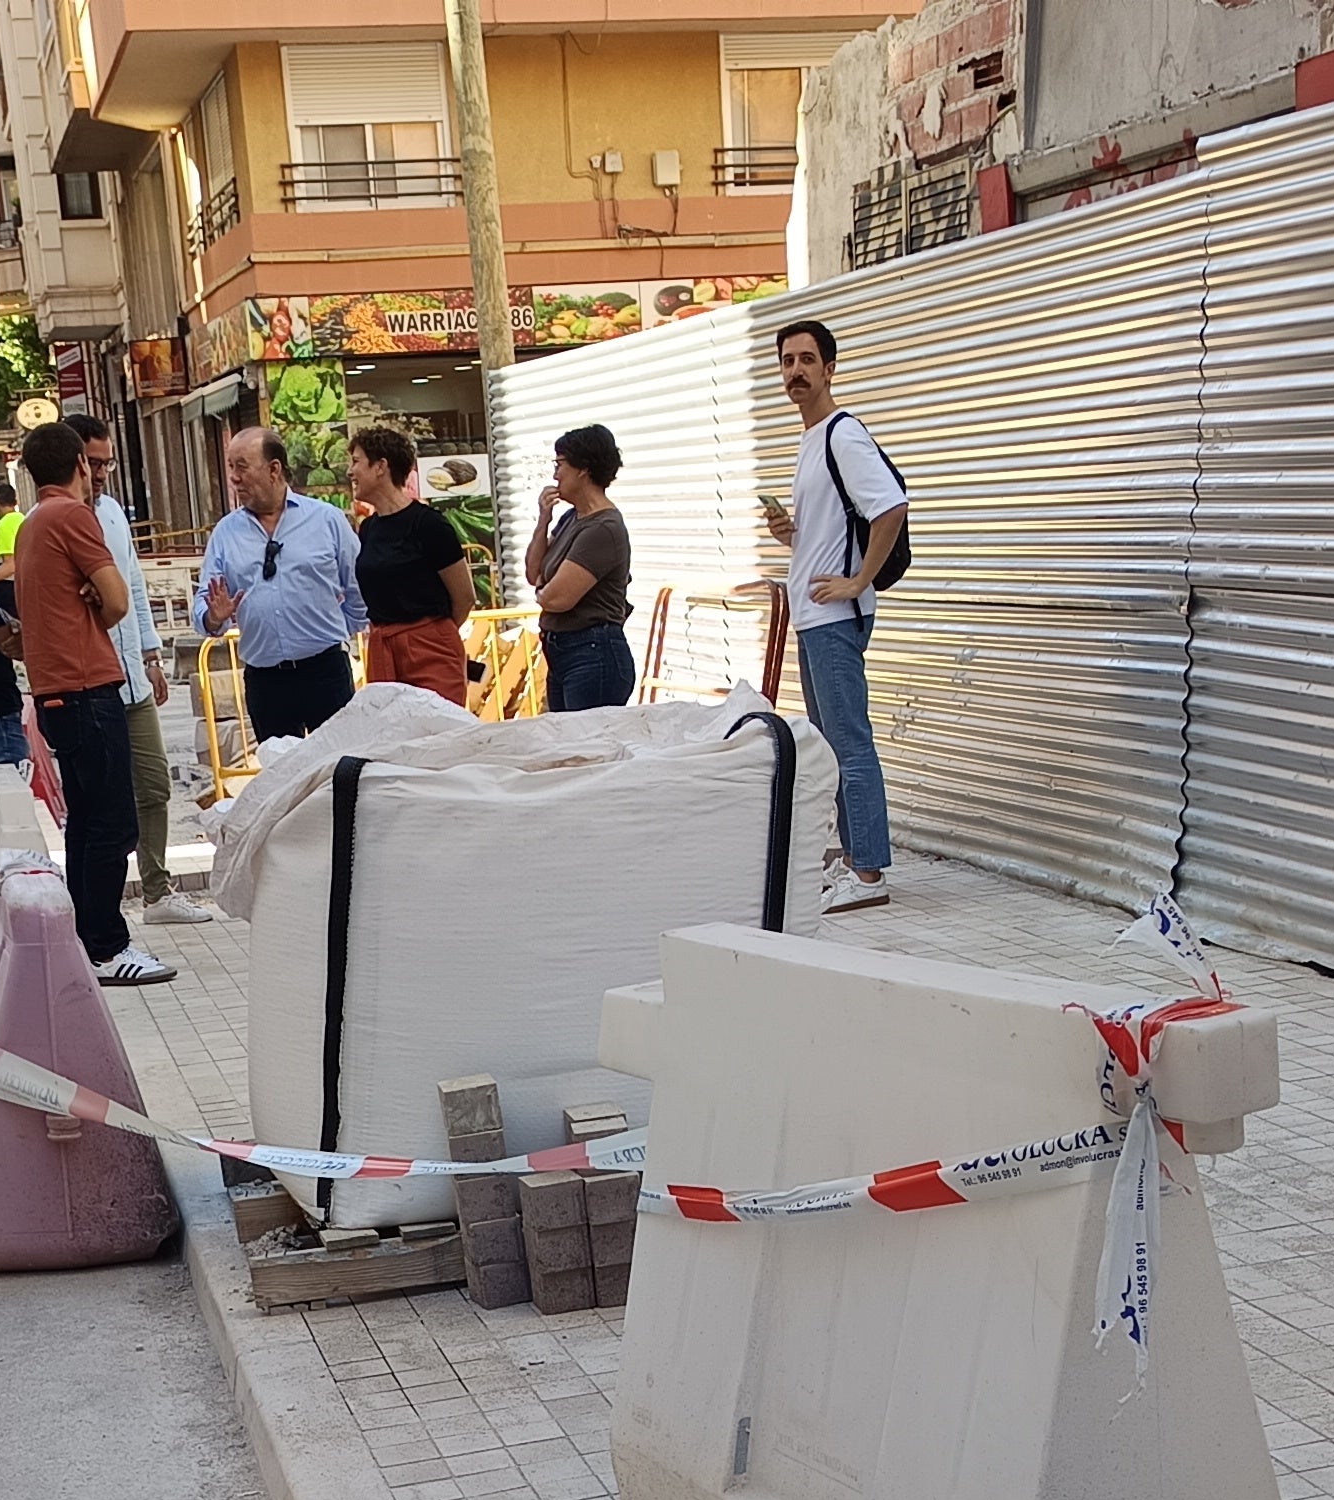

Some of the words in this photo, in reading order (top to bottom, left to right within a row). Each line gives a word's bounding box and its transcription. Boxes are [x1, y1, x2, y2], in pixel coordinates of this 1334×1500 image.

[387, 310, 479, 333] WARRIAC
[512, 308, 533, 327] 86
[1039, 1146, 1125, 1173] admon@involucras
[1136, 1242, 1146, 1255] 91
[1137, 1258, 1147, 1273] 98
[1137, 1275, 1148, 1296] 545
[1138, 1299, 1148, 1313] 96
